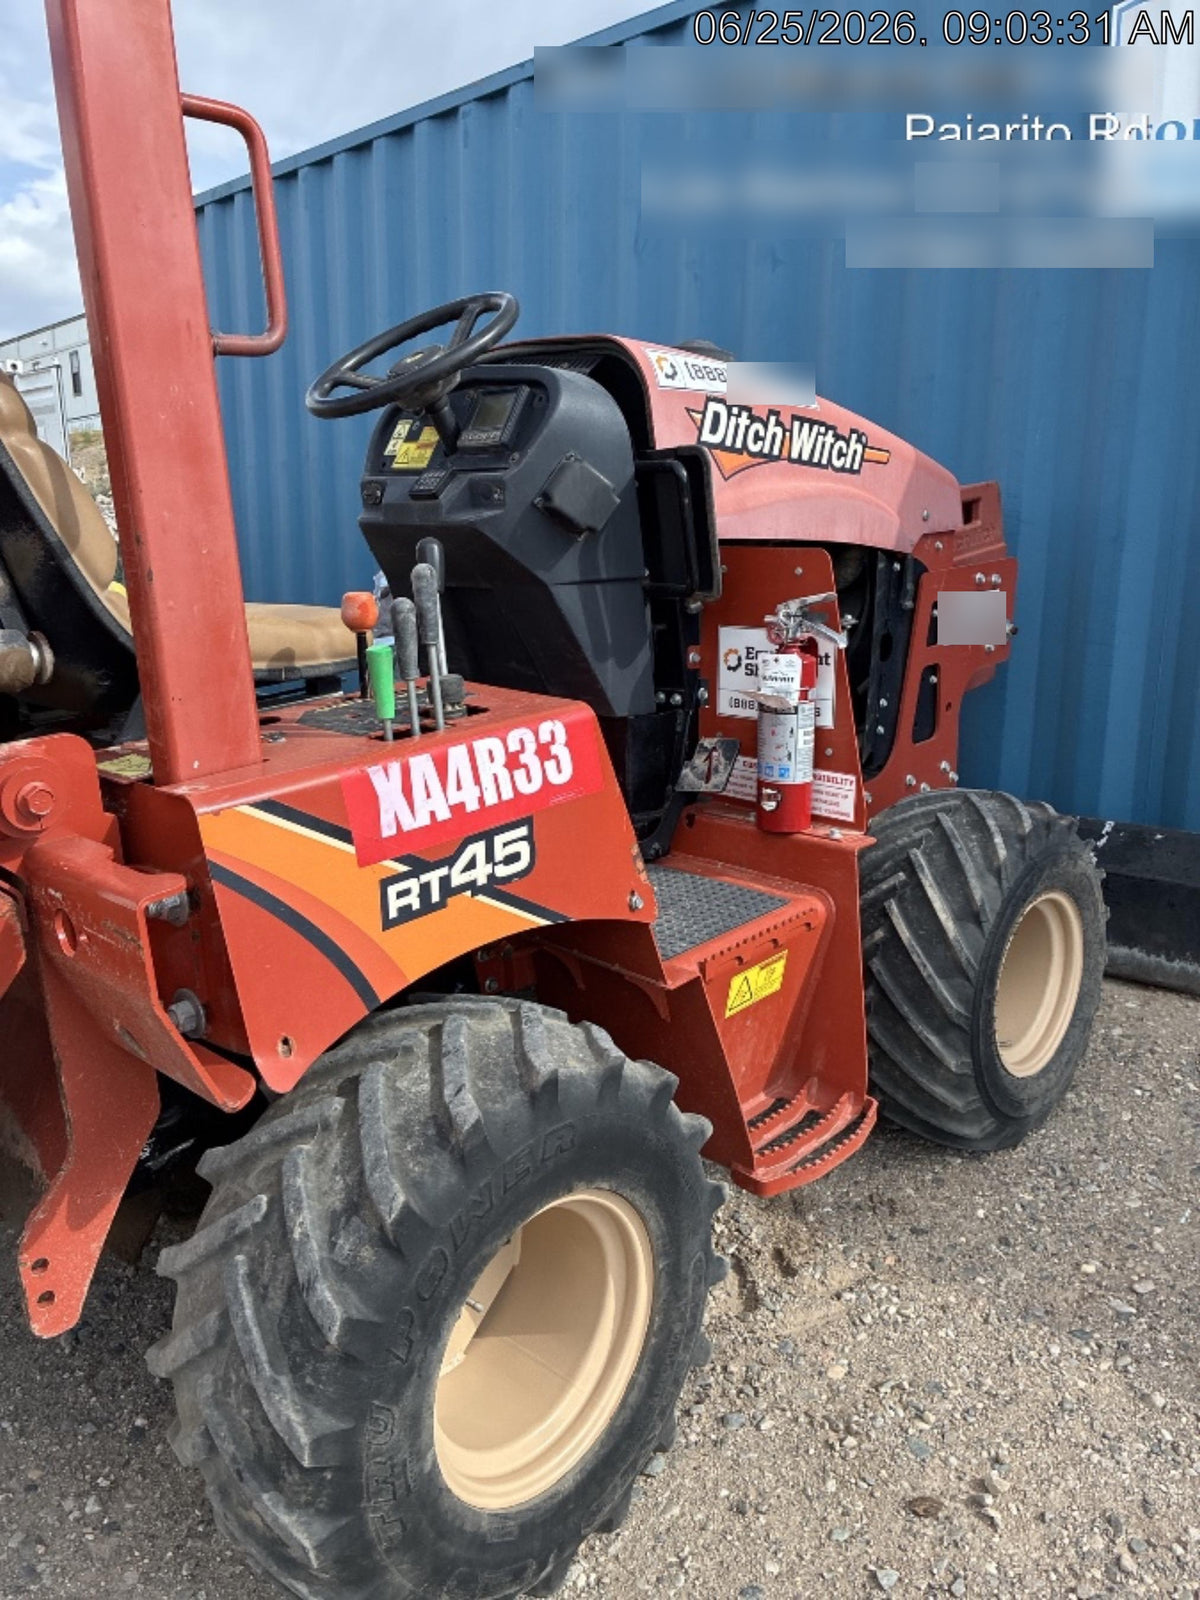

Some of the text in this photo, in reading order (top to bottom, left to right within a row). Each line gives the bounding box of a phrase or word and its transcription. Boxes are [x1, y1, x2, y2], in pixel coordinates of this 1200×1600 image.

[700, 401, 864, 470] Ditch Witch
[367, 719, 573, 838] XA4R33
[386, 825, 531, 920] RT45
